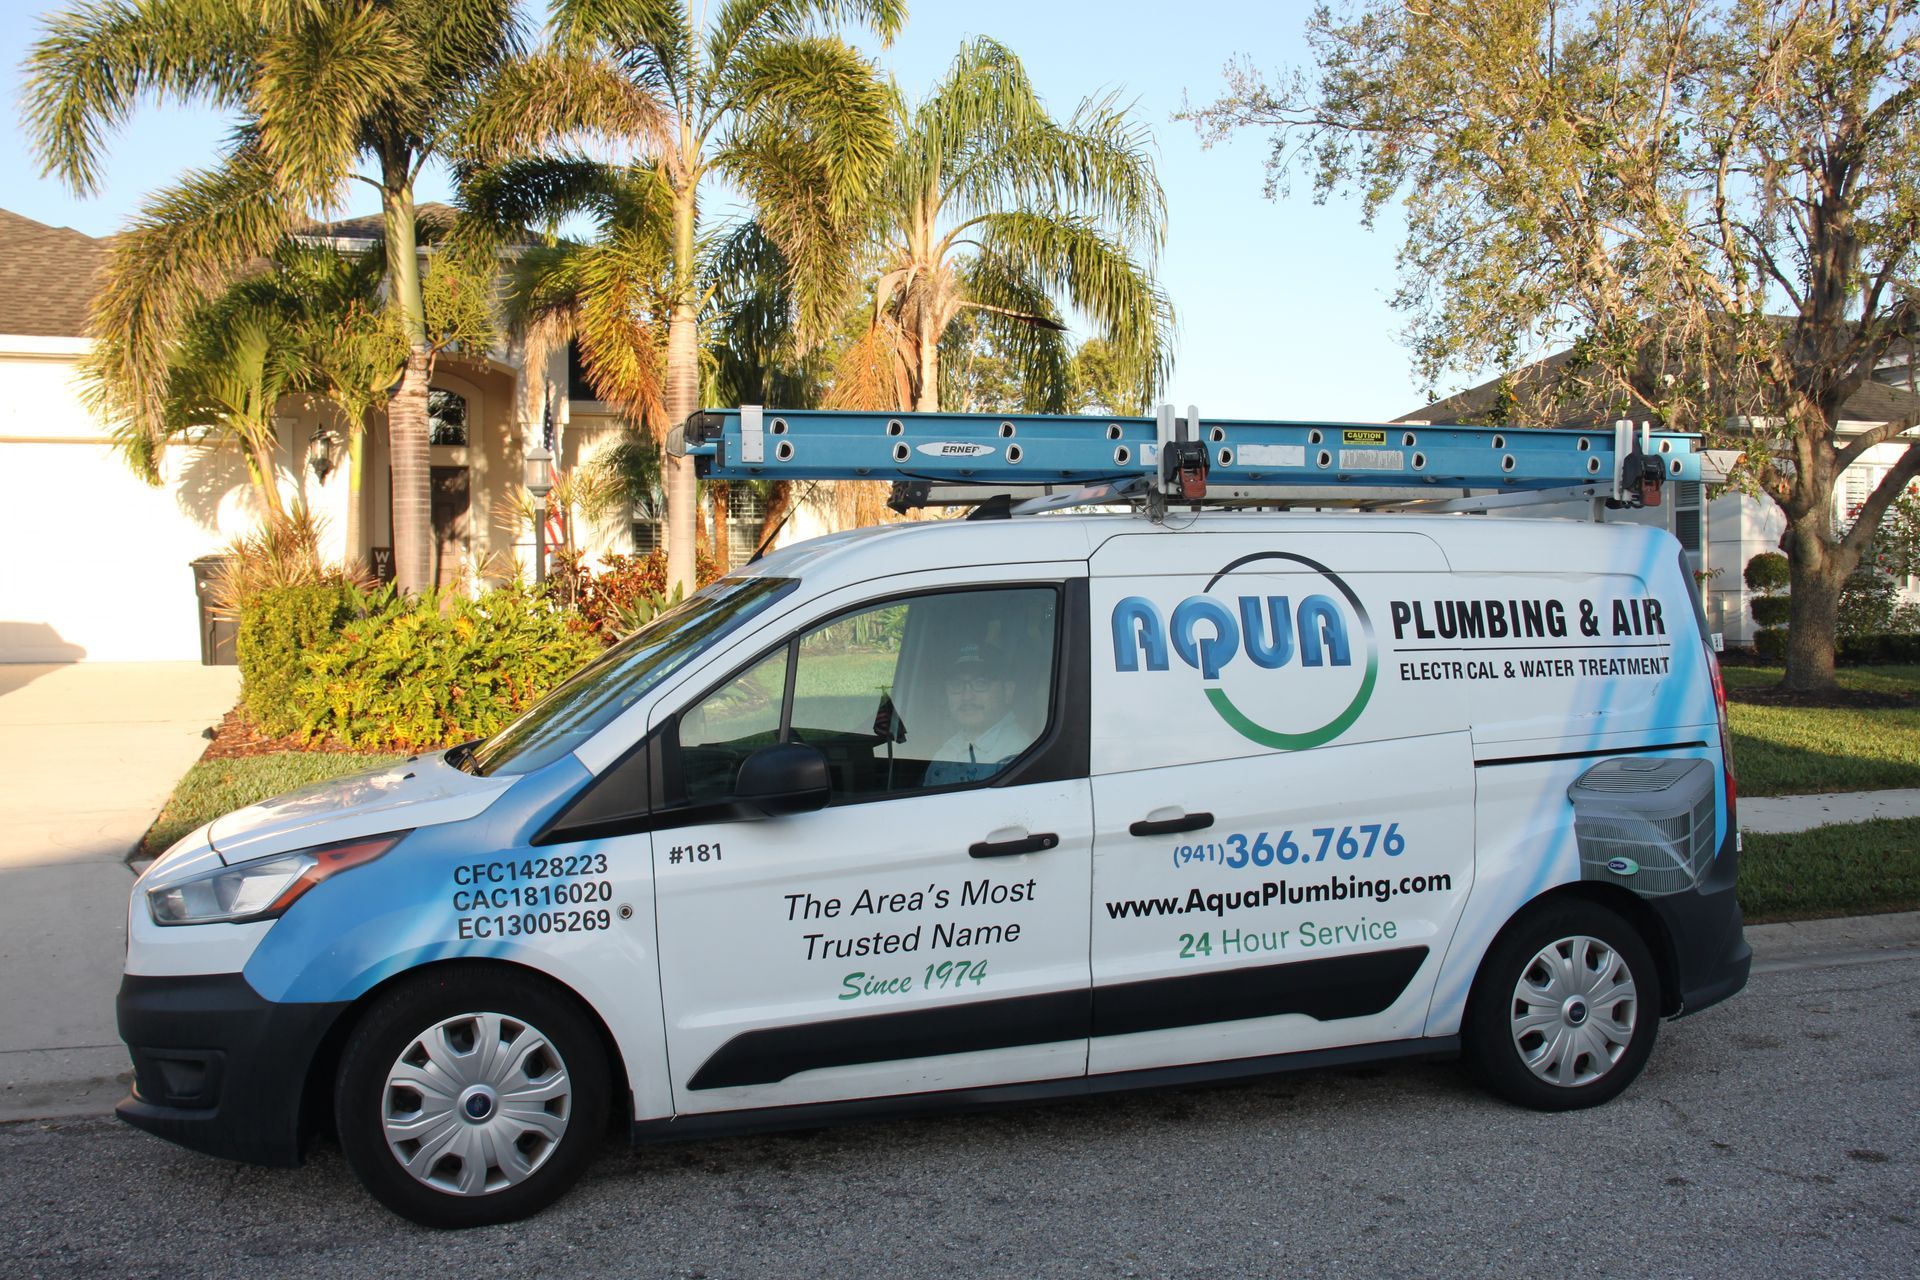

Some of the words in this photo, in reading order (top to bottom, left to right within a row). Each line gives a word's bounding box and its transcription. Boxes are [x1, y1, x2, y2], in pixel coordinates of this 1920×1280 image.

[1111, 594, 1352, 680] AQUA
[1390, 599, 1568, 639] PLUMBING
[1579, 598, 1601, 637] &
[1612, 599, 1666, 636] AIR
[1400, 661, 1499, 680] ELECTRCAL
[1504, 661, 1516, 678] &
[1520, 659, 1575, 678] WATER
[1579, 656, 1670, 676] TREATMENT
[453, 854, 608, 885] CFC1428223
[669, 843, 722, 864] #181
[453, 880, 613, 911] CAC1816020
[784, 893, 841, 920] The
[850, 884, 950, 916] Area's
[960, 879, 1036, 906] Most
[1106, 873, 1451, 919] www.AquaPlumbing.com
[458, 909, 610, 939] EC13005269
[803, 926, 921, 960] Trusted
[931, 923, 1021, 949] Name
[1179, 932, 1212, 958] 24
[1222, 928, 1289, 954] Hour
[1299, 917, 1397, 947] Service
[838, 972, 912, 1000] Since
[923, 959, 988, 991] 1974
